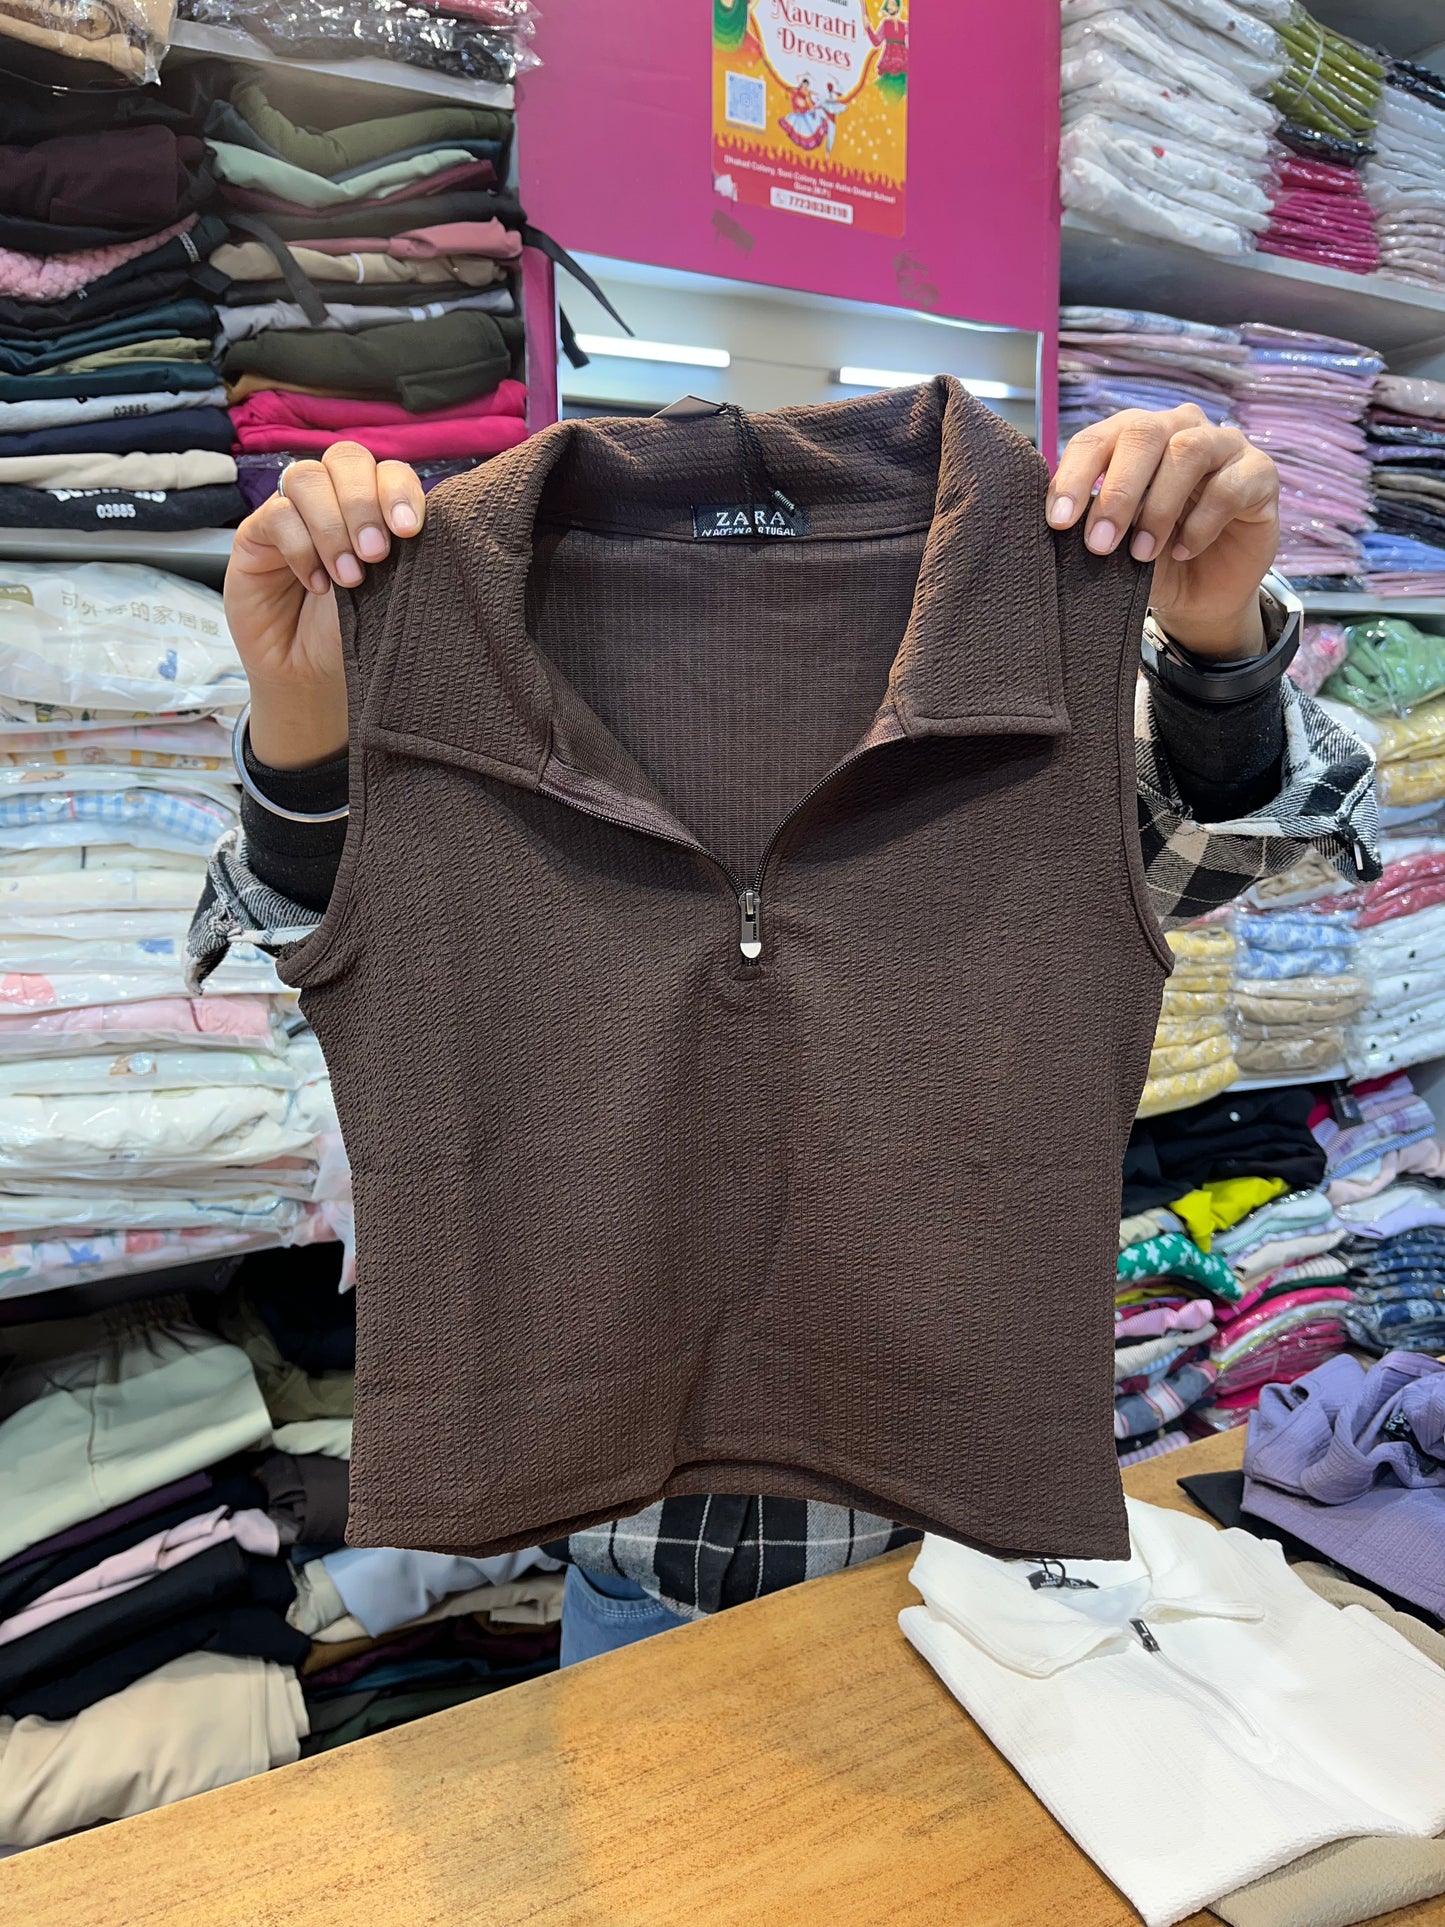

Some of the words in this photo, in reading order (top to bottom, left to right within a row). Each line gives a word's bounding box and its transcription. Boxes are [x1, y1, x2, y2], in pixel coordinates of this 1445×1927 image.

[772, 0, 856, 38] Navratri
[778, 27, 851, 67] Dresses
[96, 503, 136, 519] 03885
[716, 510, 785, 526] ZARA
[745, 526, 796, 537] PRTUGAL
